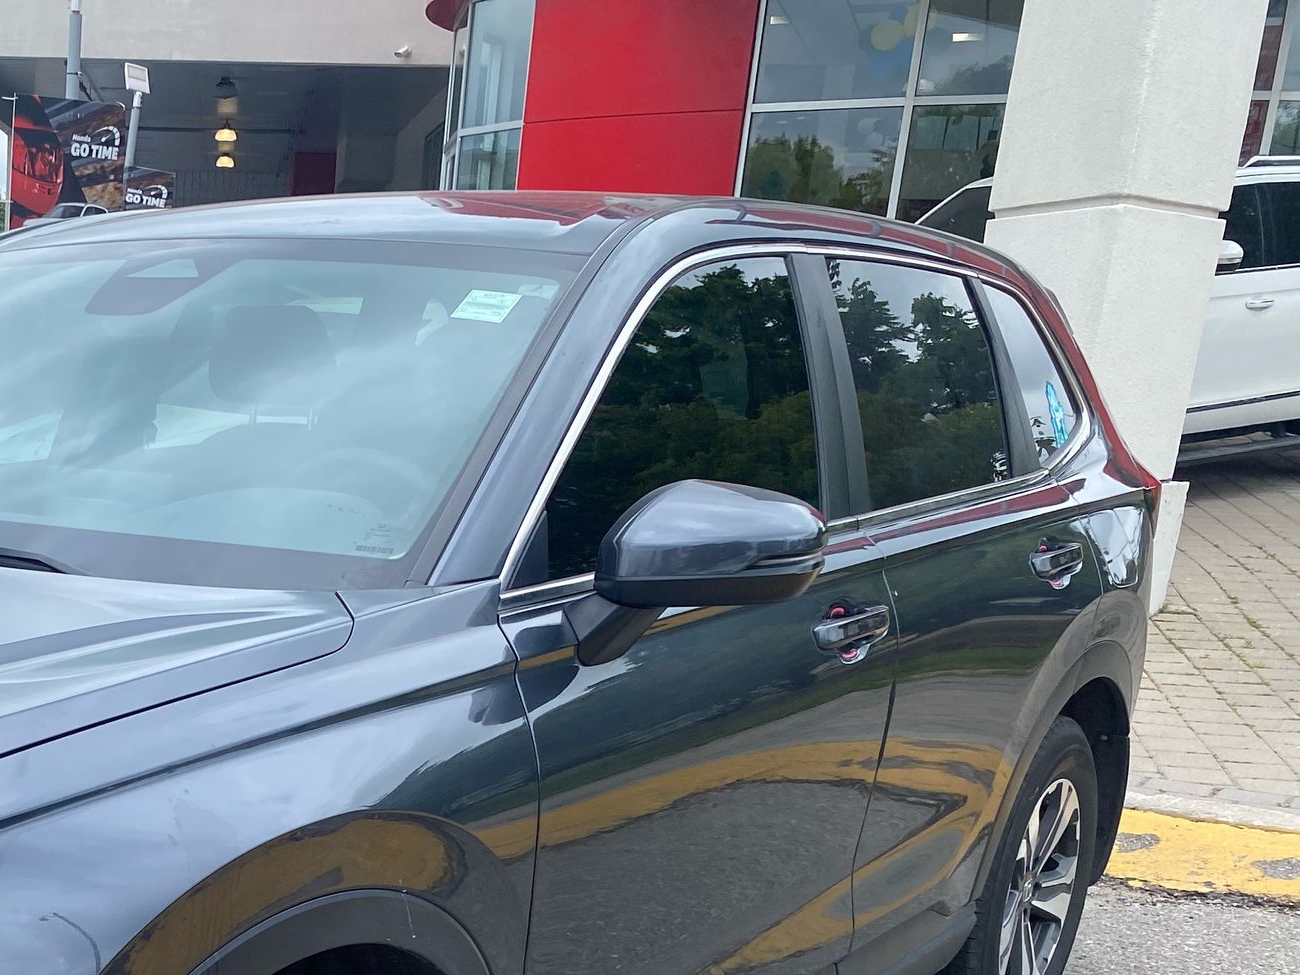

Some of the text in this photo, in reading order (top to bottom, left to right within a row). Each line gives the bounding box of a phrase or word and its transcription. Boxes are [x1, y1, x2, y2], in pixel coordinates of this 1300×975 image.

[70, 142, 119, 160] GO TIME
[125, 193, 166, 208] GO TIME
